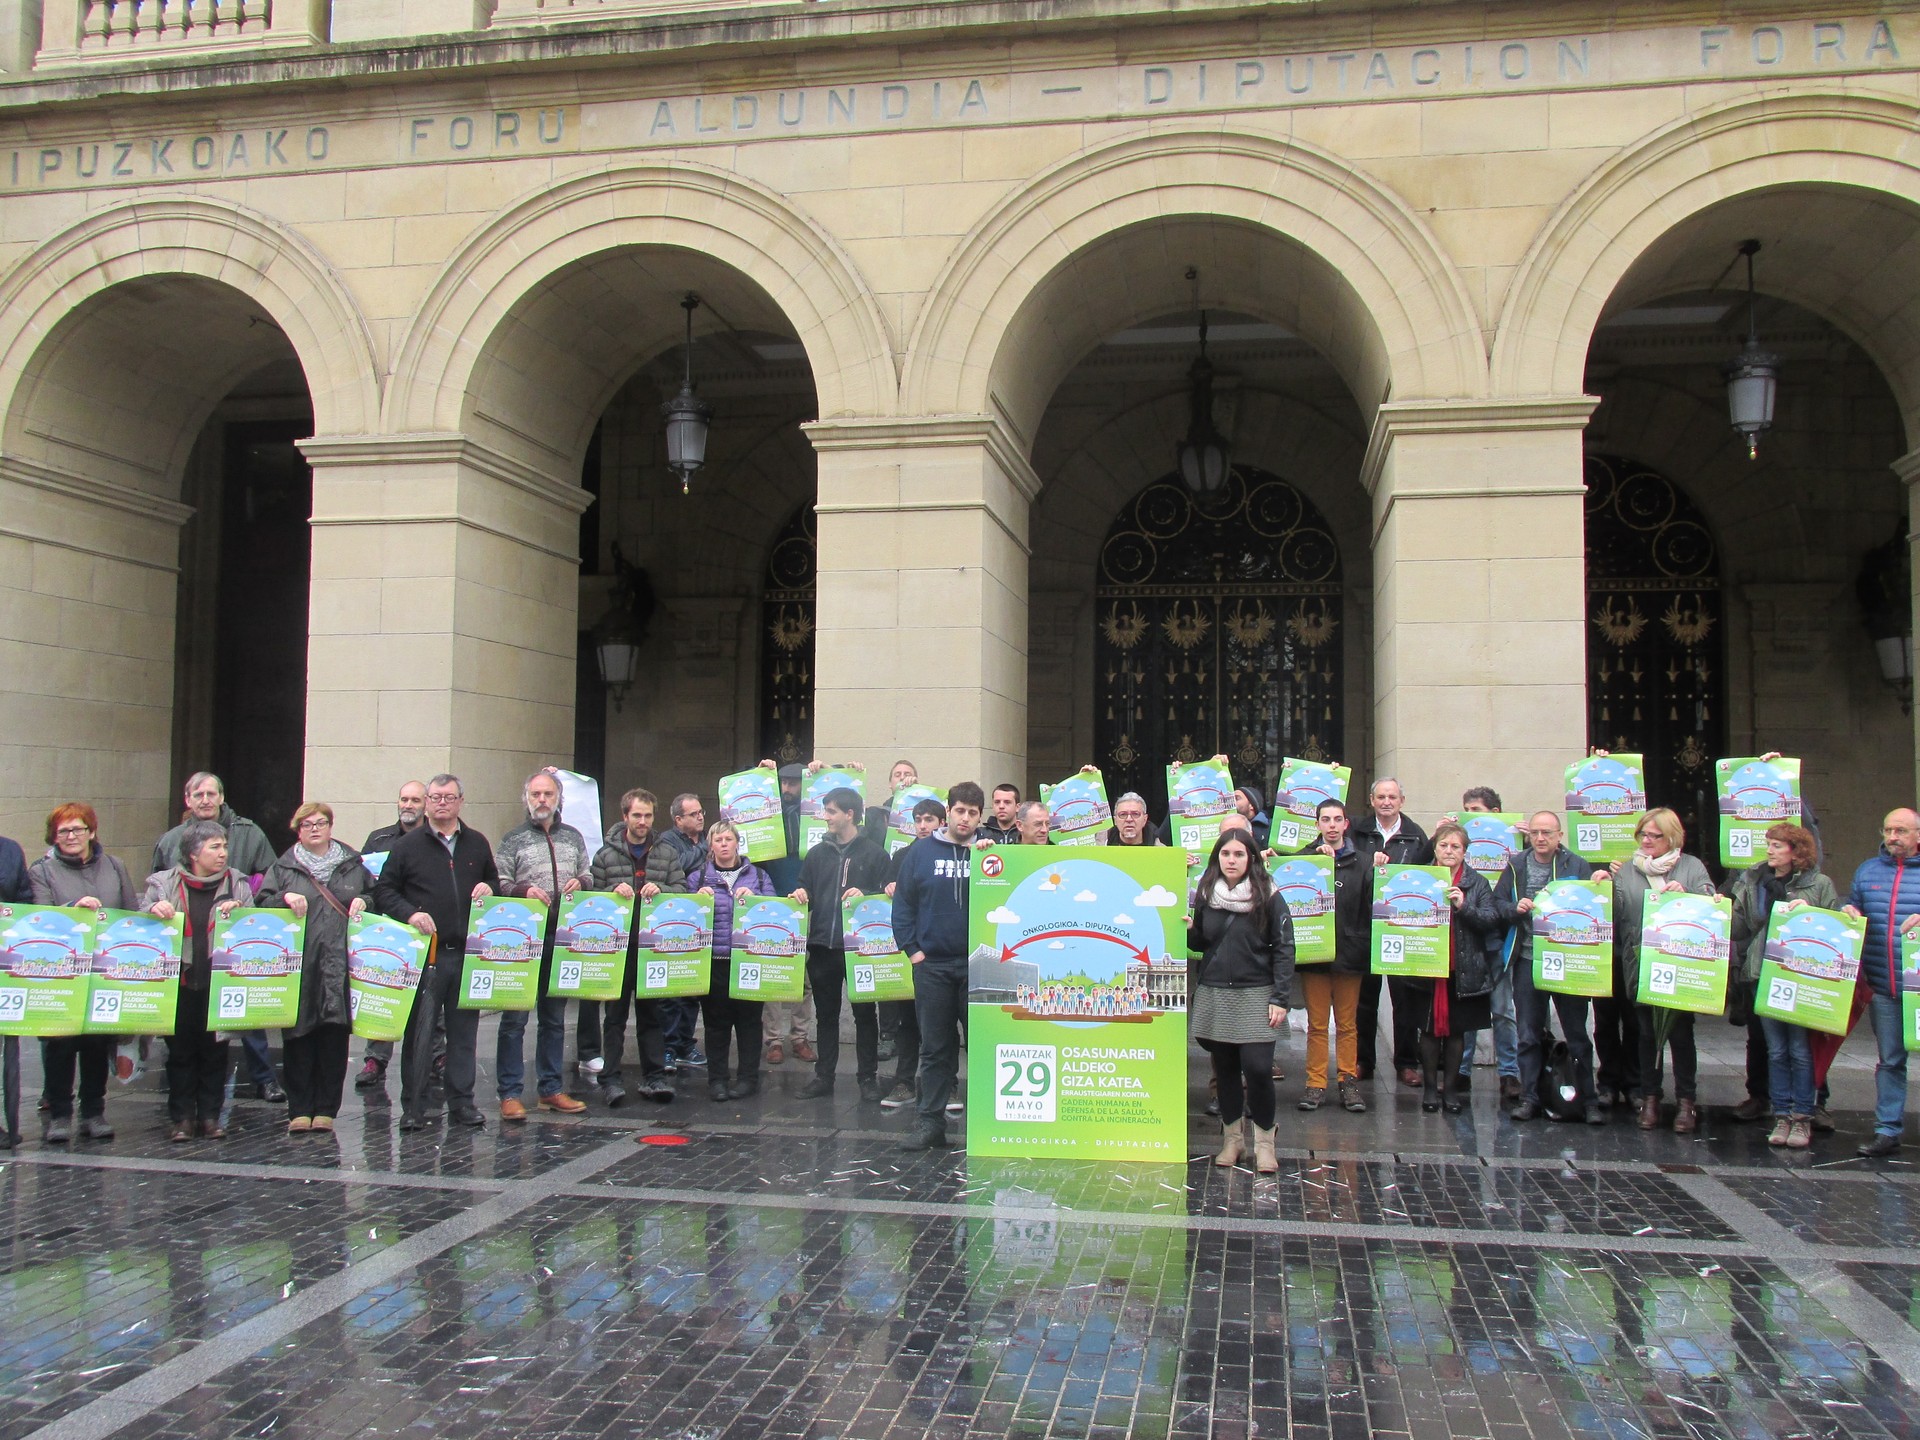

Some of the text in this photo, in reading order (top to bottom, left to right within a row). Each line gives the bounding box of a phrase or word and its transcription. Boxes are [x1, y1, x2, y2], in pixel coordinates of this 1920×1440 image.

[12, 126, 329, 185] IPUZKOAKO
[410, 107, 565, 155] FORU
[649, 79, 990, 138] ALDUNDIA
[1144, 38, 1593, 104] DIPUTACION
[1700, 20, 1901, 68] FORA
[1182, 831, 1198, 842] 29
[1280, 826, 1297, 838] 29
[1580, 830, 1598, 842] 29
[1731, 835, 1749, 848] 29
[1022, 921, 1079, 936] ONKOLOGIKOA
[1085, 922, 1130, 939] DIPUTAZIOA
[1383, 940, 1402, 954] 29
[1544, 957, 1562, 971] 29
[561, 967, 579, 980] 29
[648, 966, 666, 980] 29
[741, 968, 759, 981] 29
[856, 970, 872, 984] 29
[1652, 968, 1673, 984] 29
[472, 976, 492, 990] 29
[1771, 984, 1793, 1001] 29
[0, 995, 23, 1010] 29
[95, 997, 118, 1012] 29
[222, 993, 244, 1008] 29
[1000, 1049, 1052, 1059] MAIATZAK
[1061, 1047, 1155, 1060] OSASUNAREN
[1062, 1061, 1117, 1073] ALDEKO
[1000, 1061, 1051, 1097] 29
[1061, 1076, 1143, 1089] GIZA KATEA
[1061, 1090, 1120, 1098] ERRAUSTEGIAREN
[1006, 1101, 1043, 1110] MAYO
[1107, 1115, 1162, 1124] INCINERACIÓN
[991, 1136, 1076, 1145] ONKOLOGIKOA
[1096, 1140, 1169, 1148] DIPUTAZIOA
